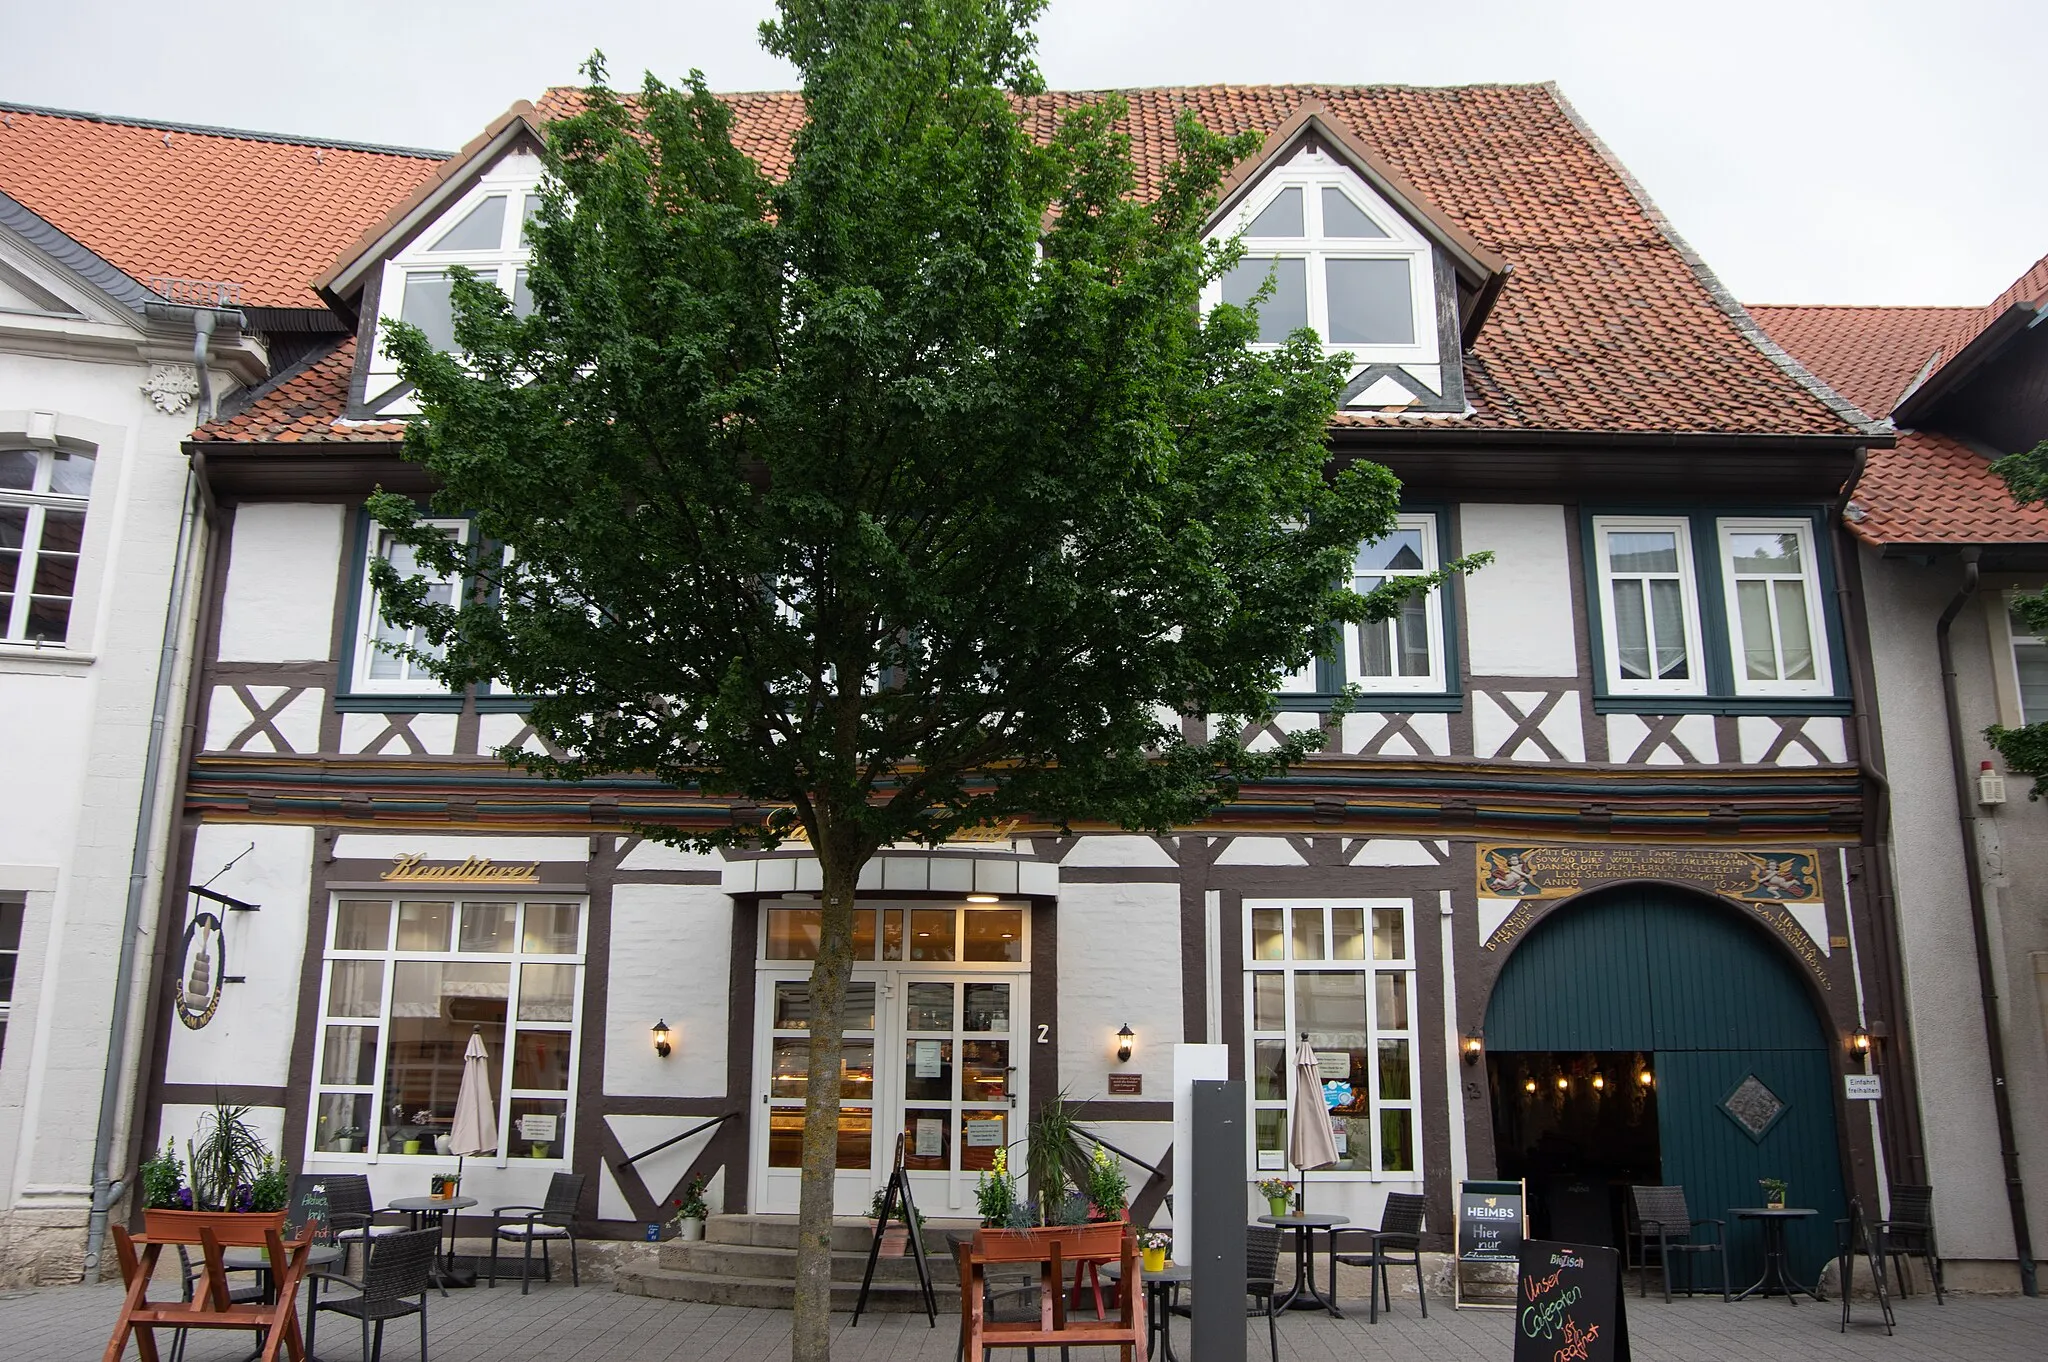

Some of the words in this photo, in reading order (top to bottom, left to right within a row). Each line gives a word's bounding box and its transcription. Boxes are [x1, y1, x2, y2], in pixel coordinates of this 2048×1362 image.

[1537, 848, 1559, 856] MIT
[1561, 848, 1605, 857] GOTTES
[380, 851, 541, 881] Konditorei
[1606, 863, 1628, 871] DEM
[1555, 870, 1582, 878] LOBE
[1543, 878, 1579, 886] ANNO
[1754, 902, 1805, 955] CATHARINA
[1778, 911, 1817, 957] URSULA
[199, 986, 221, 1024] MARKT
[1037, 1024, 1049, 1043] 2
[1849, 1078, 1876, 1086] Einfahrt
[1467, 1206, 1515, 1218] HEIMBS
[1473, 1223, 1500, 1239] Hier
[1478, 1240, 1502, 1249] nur
[1523, 1268, 1563, 1302] Unser
